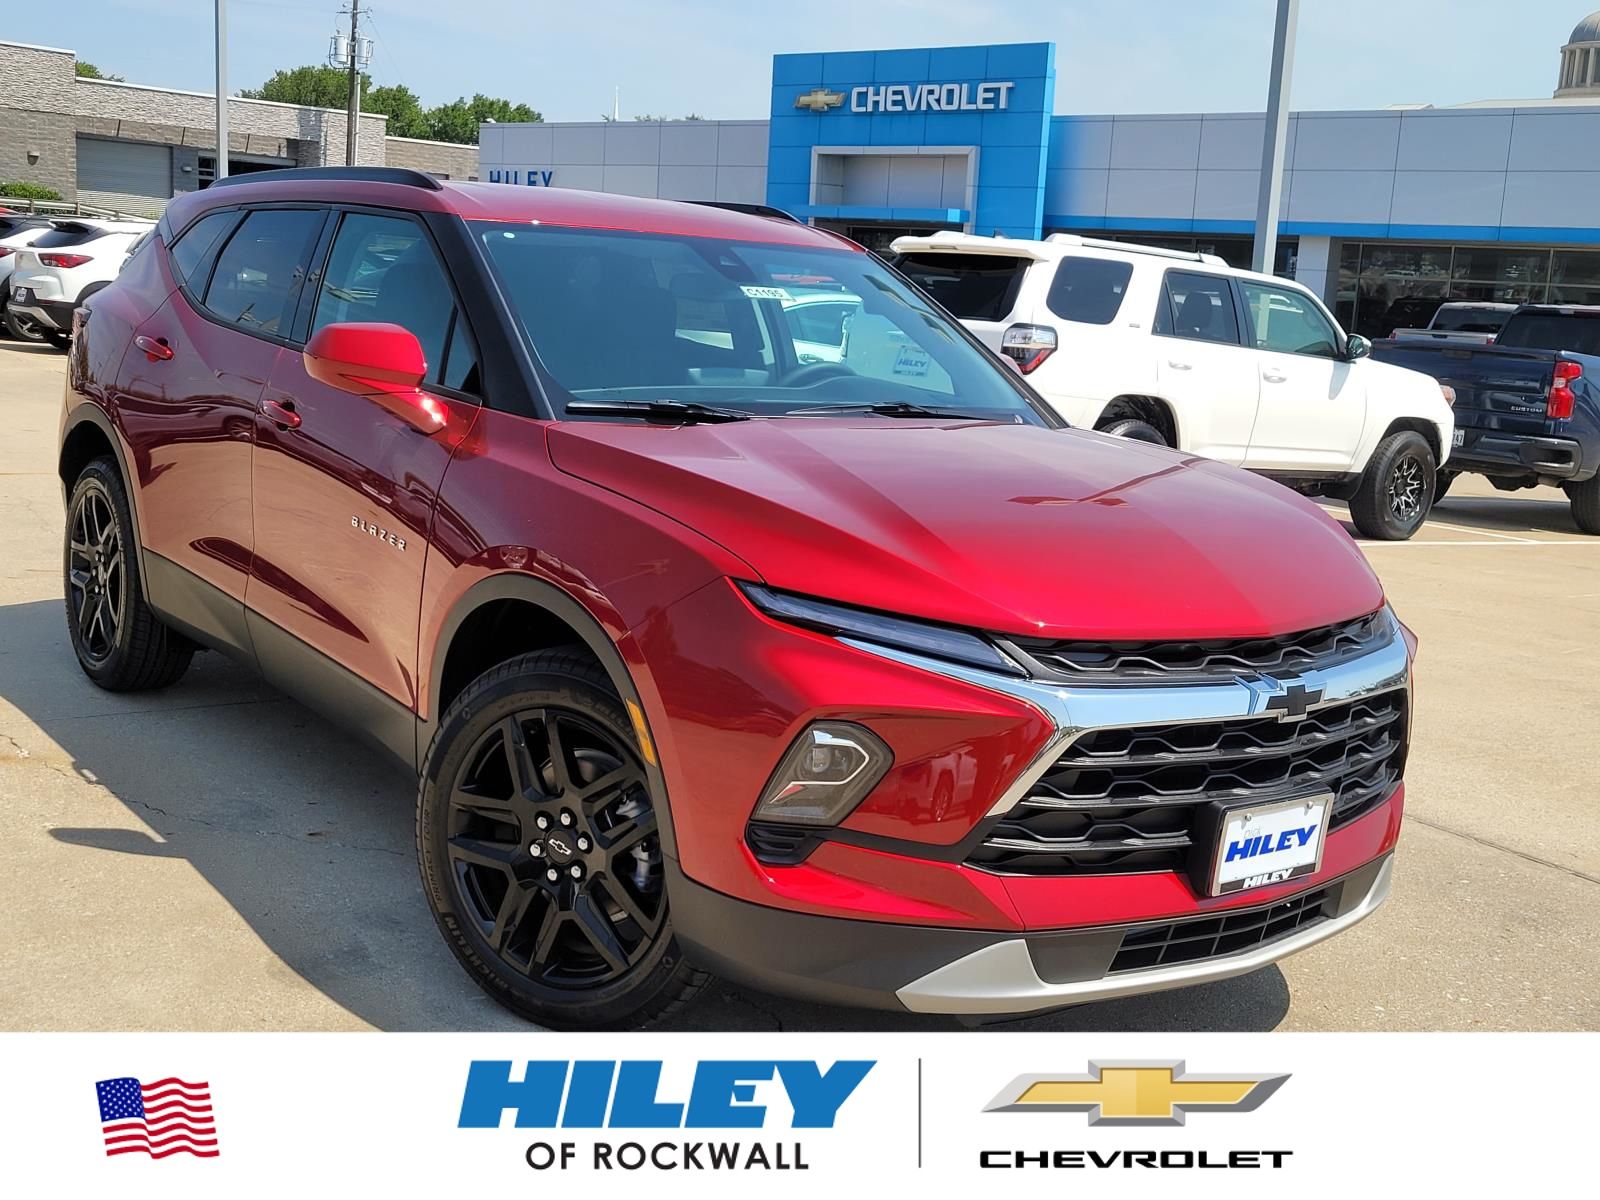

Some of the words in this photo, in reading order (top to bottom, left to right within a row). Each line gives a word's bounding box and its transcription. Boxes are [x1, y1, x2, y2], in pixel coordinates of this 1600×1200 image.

[851, 82, 1016, 112] CHEVROLET
[1510, 405, 1543, 413] CUSTOM
[351, 515, 407, 552] BLAZER
[1225, 824, 1319, 863] HILEY
[1243, 868, 1294, 889] HILEY
[444, 915, 509, 990] MICHELIN
